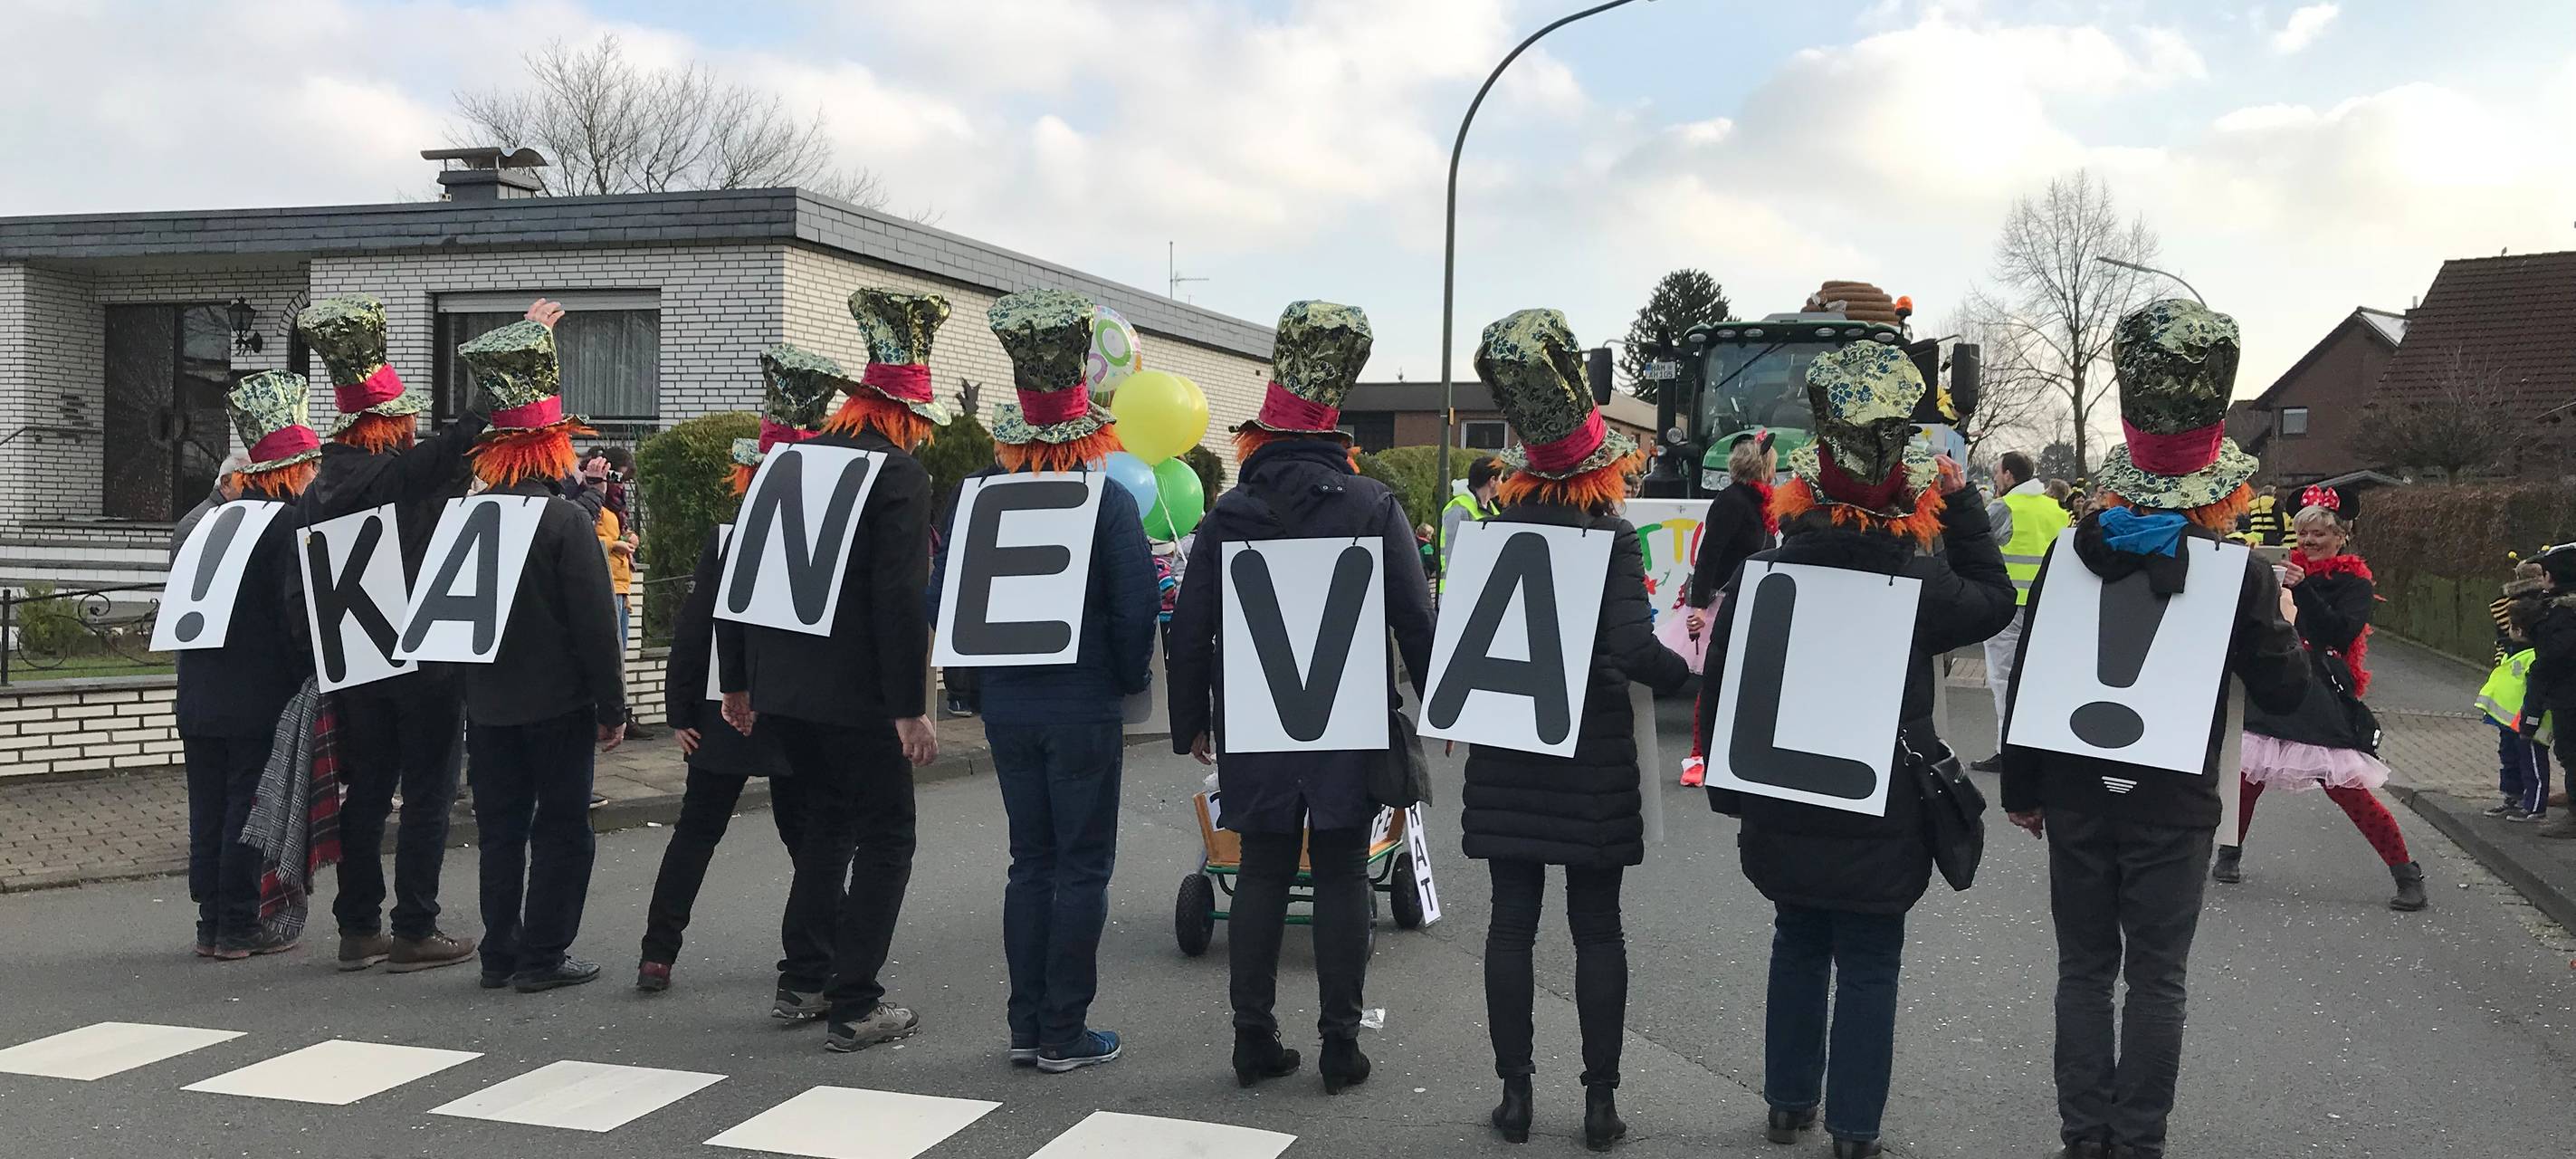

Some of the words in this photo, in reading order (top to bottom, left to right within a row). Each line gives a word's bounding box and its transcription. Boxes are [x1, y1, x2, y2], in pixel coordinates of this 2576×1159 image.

[306, 514, 407, 684] K
[401, 501, 501, 656] A
[727, 450, 871, 626] N
[951, 480, 1089, 656] E
[1229, 544, 1374, 742] V
[1427, 531, 1571, 745] A
[1728, 572, 1877, 800] L
